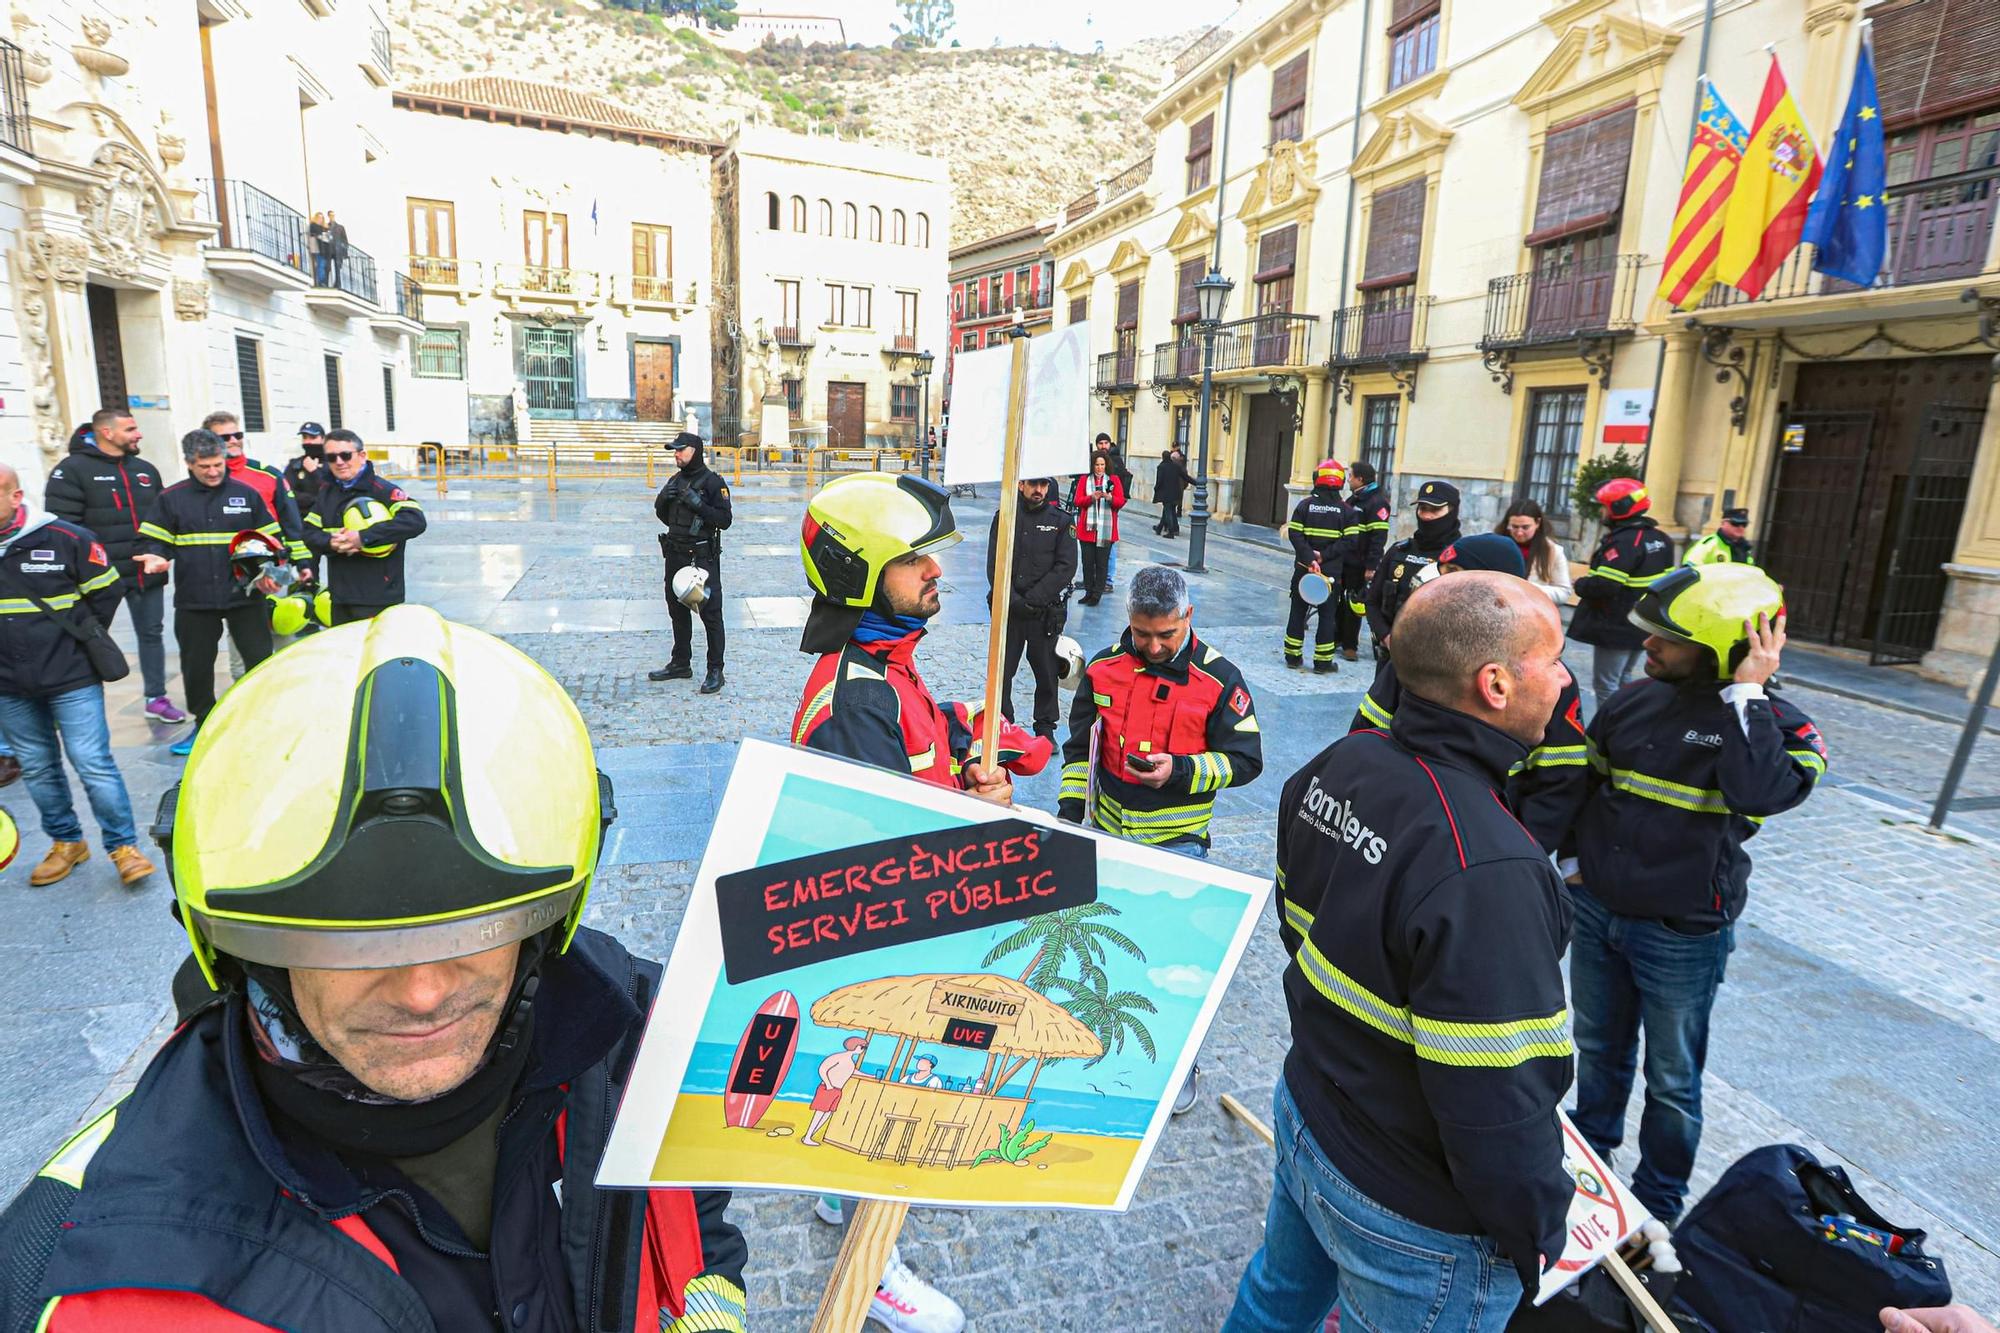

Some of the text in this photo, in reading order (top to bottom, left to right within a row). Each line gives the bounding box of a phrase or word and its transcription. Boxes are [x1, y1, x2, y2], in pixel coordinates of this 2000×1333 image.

[763, 832, 1040, 911] EMERGÈNCIES
[767, 870, 1056, 954] SERVEI PÚBLIC
[941, 991, 1017, 1016] XIRINGUITO
[952, 1026, 986, 1044] UVE
[1570, 1213, 1610, 1250] UVE
